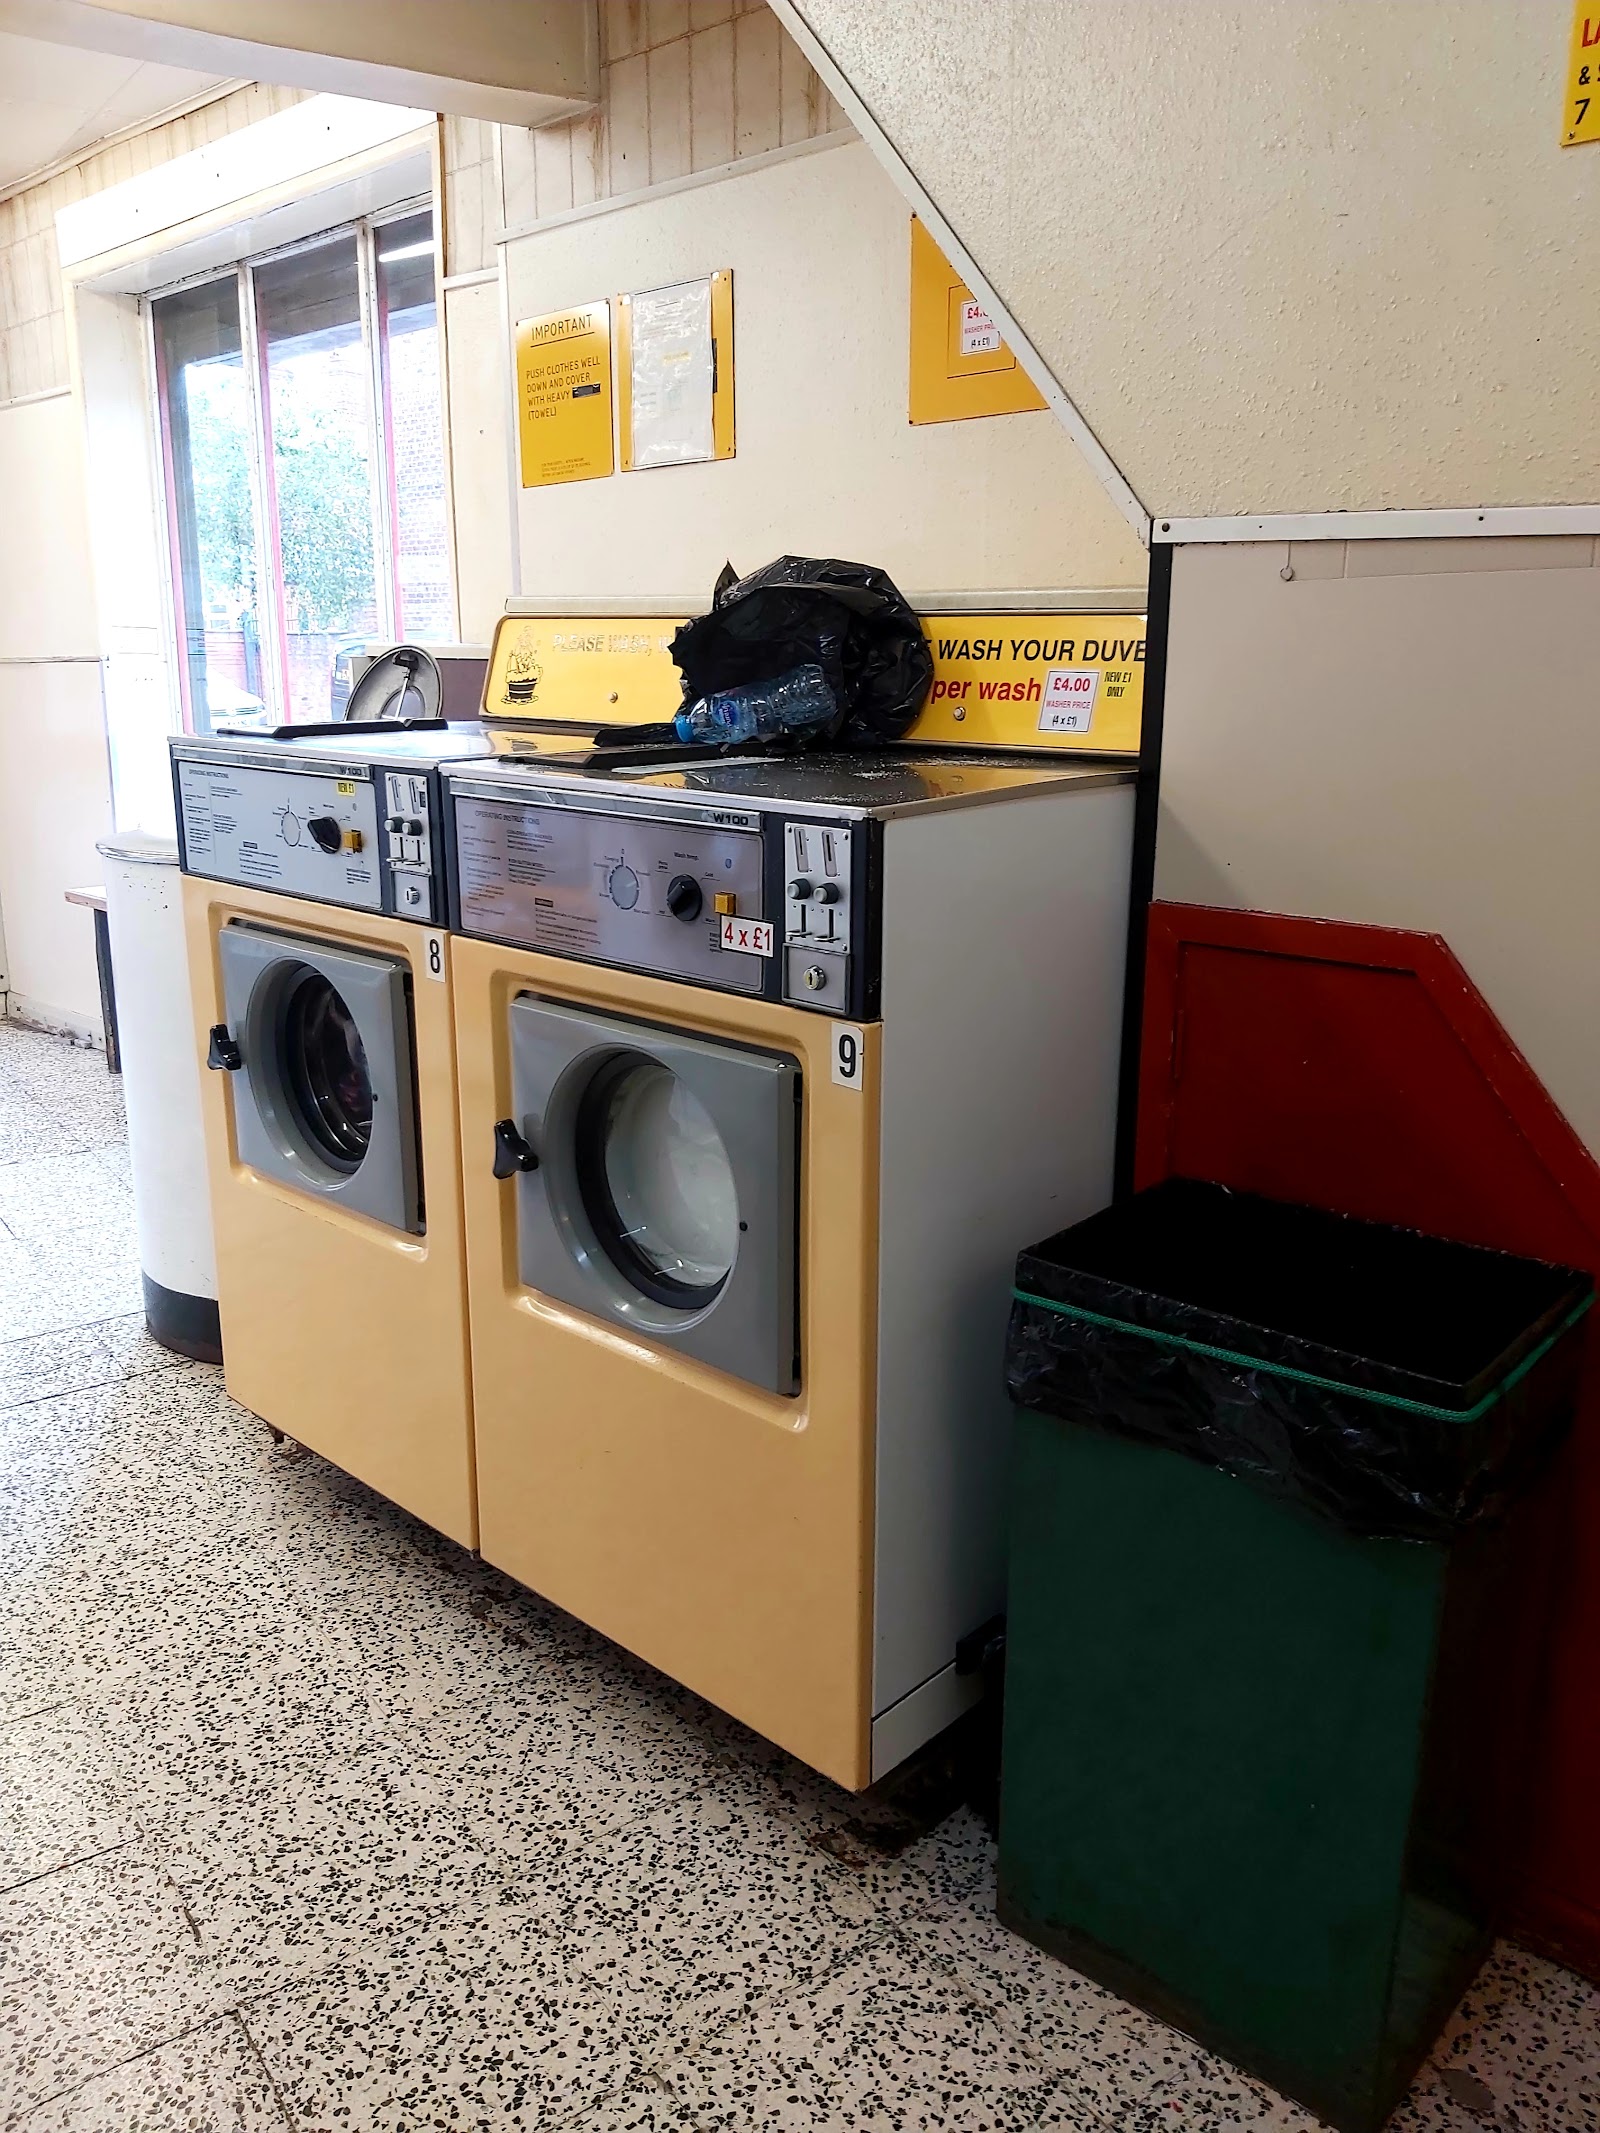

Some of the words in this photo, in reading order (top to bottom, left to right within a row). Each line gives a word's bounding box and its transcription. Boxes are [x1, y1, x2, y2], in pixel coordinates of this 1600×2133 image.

[1578, 66, 1591, 85] &
[1575, 98, 1591, 125] 7
[531, 314, 593, 341] IMPORTANT
[526, 366, 545, 380] PUSH
[546, 360, 579, 376] CLOTHES
[580, 355, 601, 369] WELL
[526, 381, 548, 393] DOWN
[549, 377, 564, 389] AND
[565, 372, 591, 386] COVER
[528, 395, 545, 407] WITH
[546, 390, 570, 403] HEAVY
[528, 406, 557, 420] (TOWEL)
[552, 634, 605, 653] PLEASE
[938, 639, 1003, 661] WASH
[1010, 639, 1076, 662] YOUR
[1082, 639, 1147, 662] DUVE
[1053, 677, 1091, 692] £4.00
[1104, 671, 1122, 683] NEW
[1122, 672, 1132, 683] £1
[930, 679, 972, 704] per
[978, 677, 1041, 702] wash
[1106, 686, 1125, 697] ONLY
[1046, 700, 1071, 709] WASHER
[1071, 700, 1091, 710] PRICE
[1052, 715, 1059, 727] (4
[1060, 717, 1066, 725] x
[1066, 716, 1078, 727] £1)
[713, 812, 749, 826] W100
[724, 922, 734, 944] 4
[738, 929, 748, 947] x
[753, 926, 770, 951] £1
[429, 937, 441, 974] 8
[838, 1033, 857, 1079] 9
